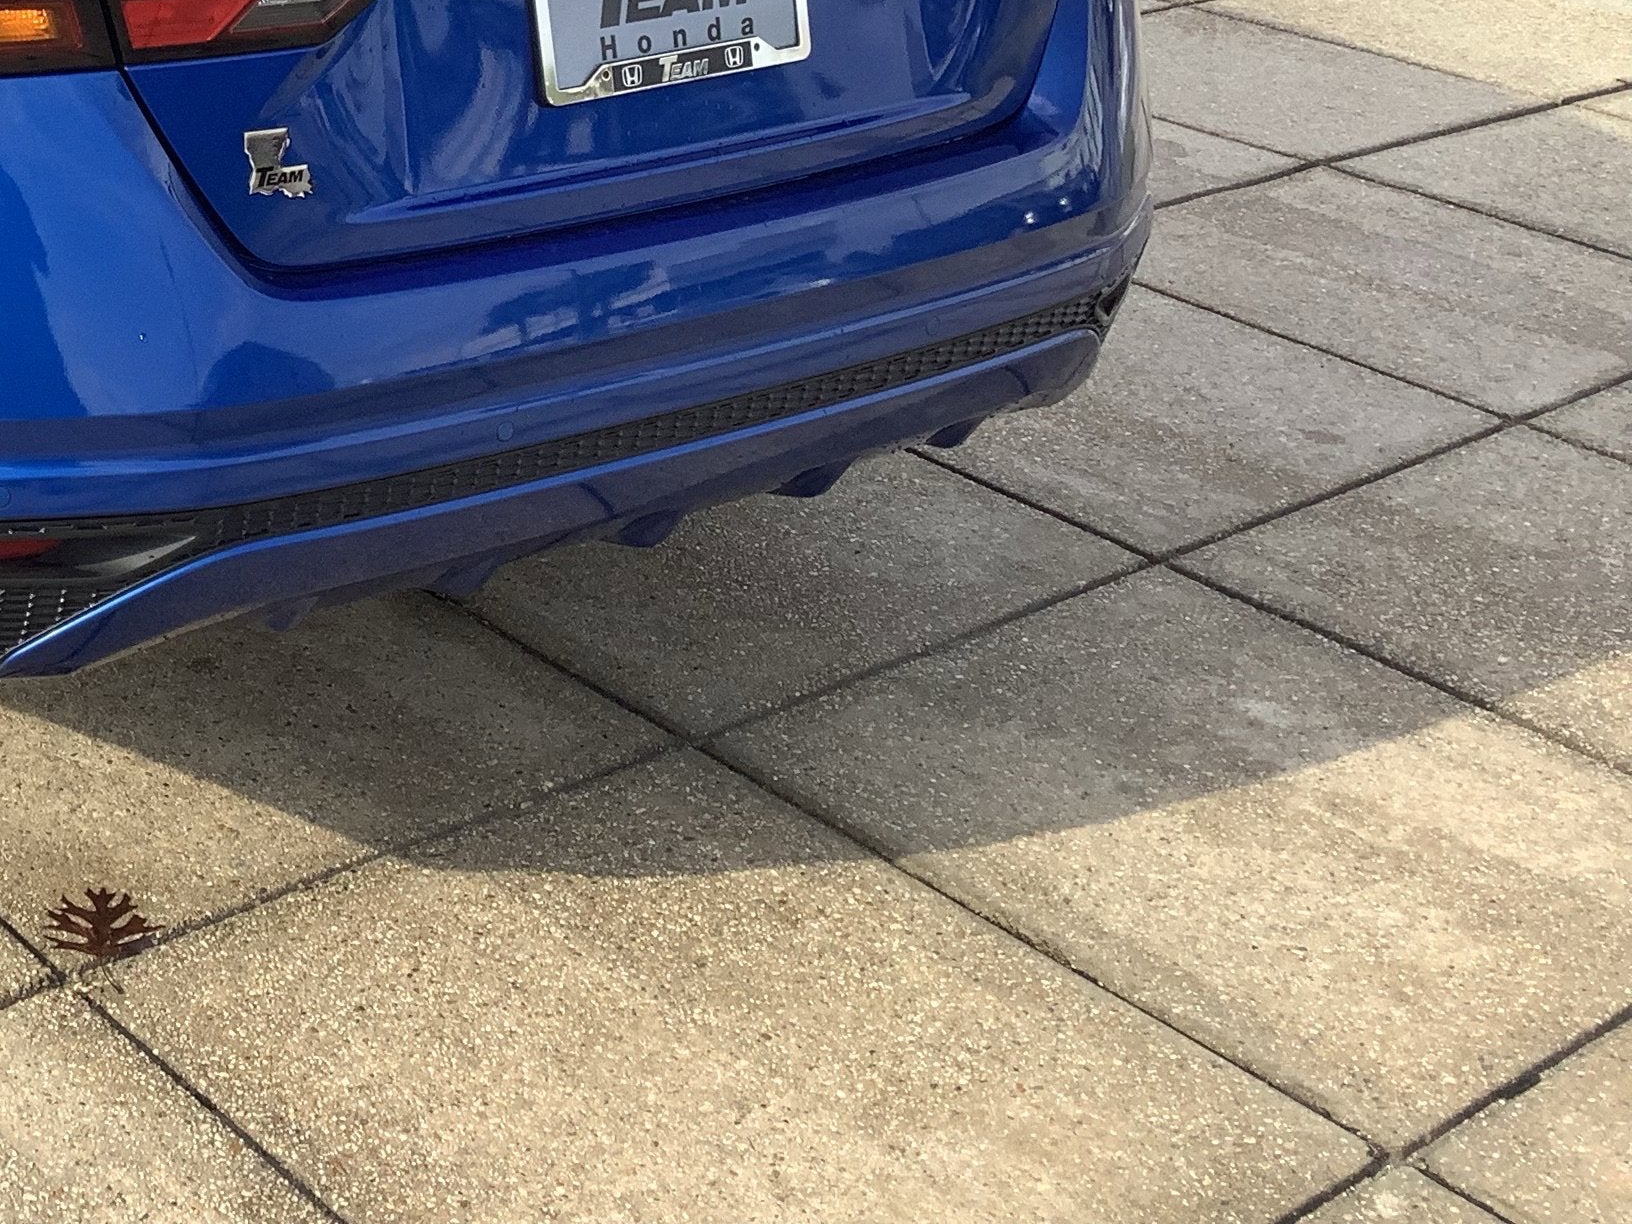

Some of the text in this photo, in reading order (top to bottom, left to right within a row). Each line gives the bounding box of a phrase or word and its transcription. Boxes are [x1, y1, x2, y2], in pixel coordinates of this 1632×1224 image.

[600, 16, 755, 61] Honda
[659, 55, 709, 83] TEAM
[256, 166, 304, 187] TEAM
